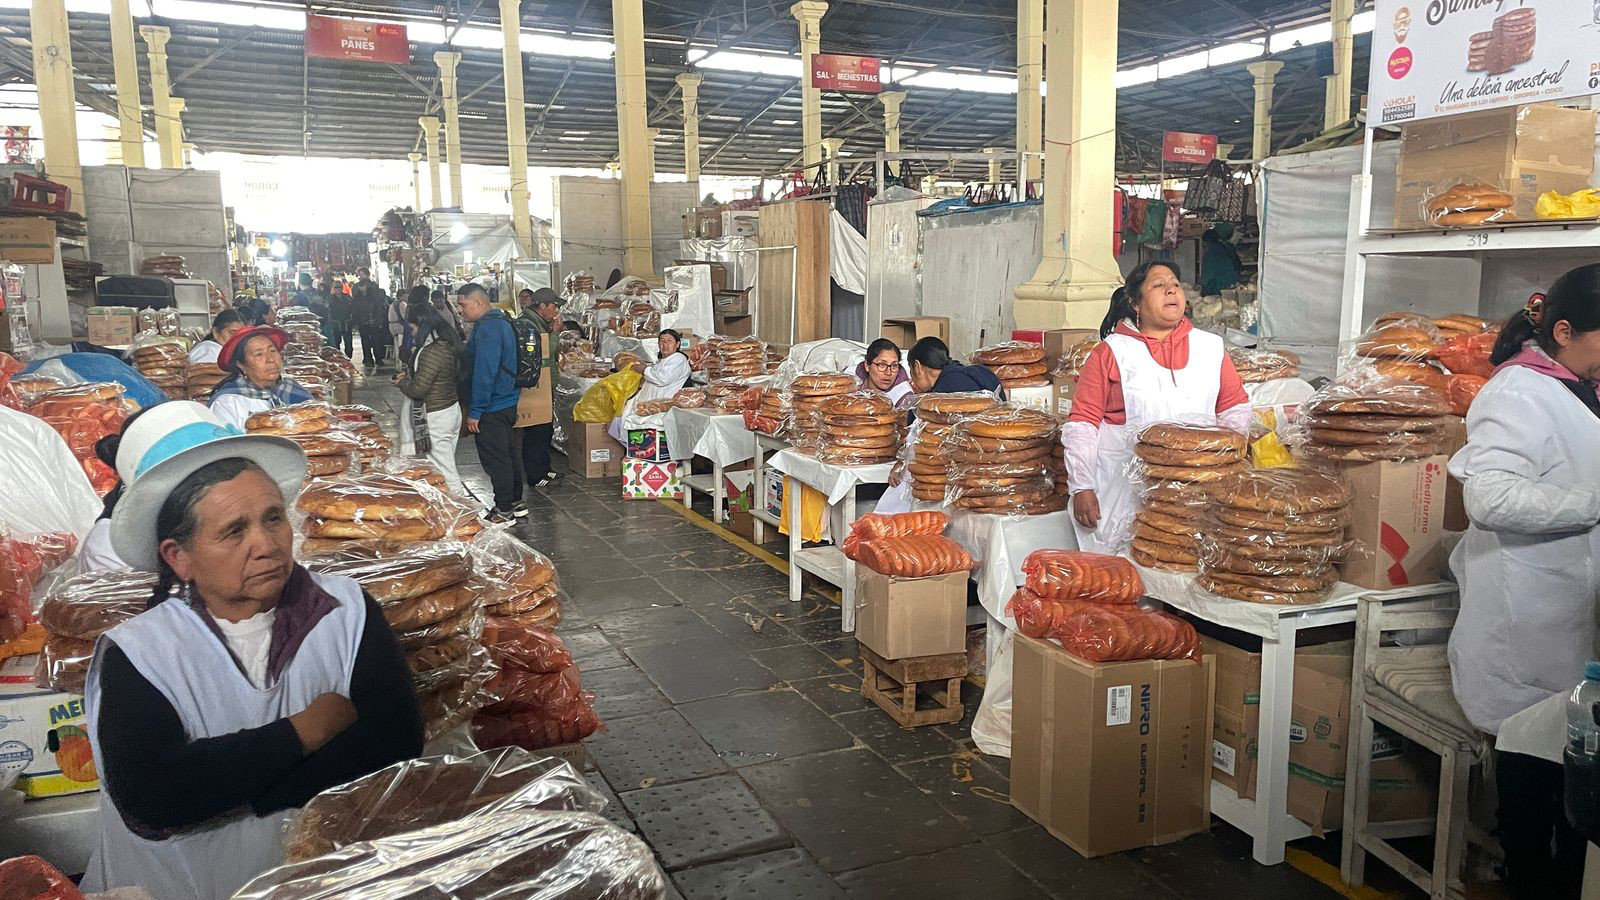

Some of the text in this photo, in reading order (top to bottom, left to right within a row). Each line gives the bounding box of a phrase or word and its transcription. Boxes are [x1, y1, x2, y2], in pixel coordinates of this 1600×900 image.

[341, 39, 375, 51] PANES
[816, 71, 830, 79] SAL
[837, 73, 878, 82] MENESTRAS
[1440, 60, 1570, 103] Una delicia ancestral
[1467, 233, 1488, 246] 319
[1422, 473, 1433, 534] Medifarma
[1140, 684, 1151, 735] NIPRO
